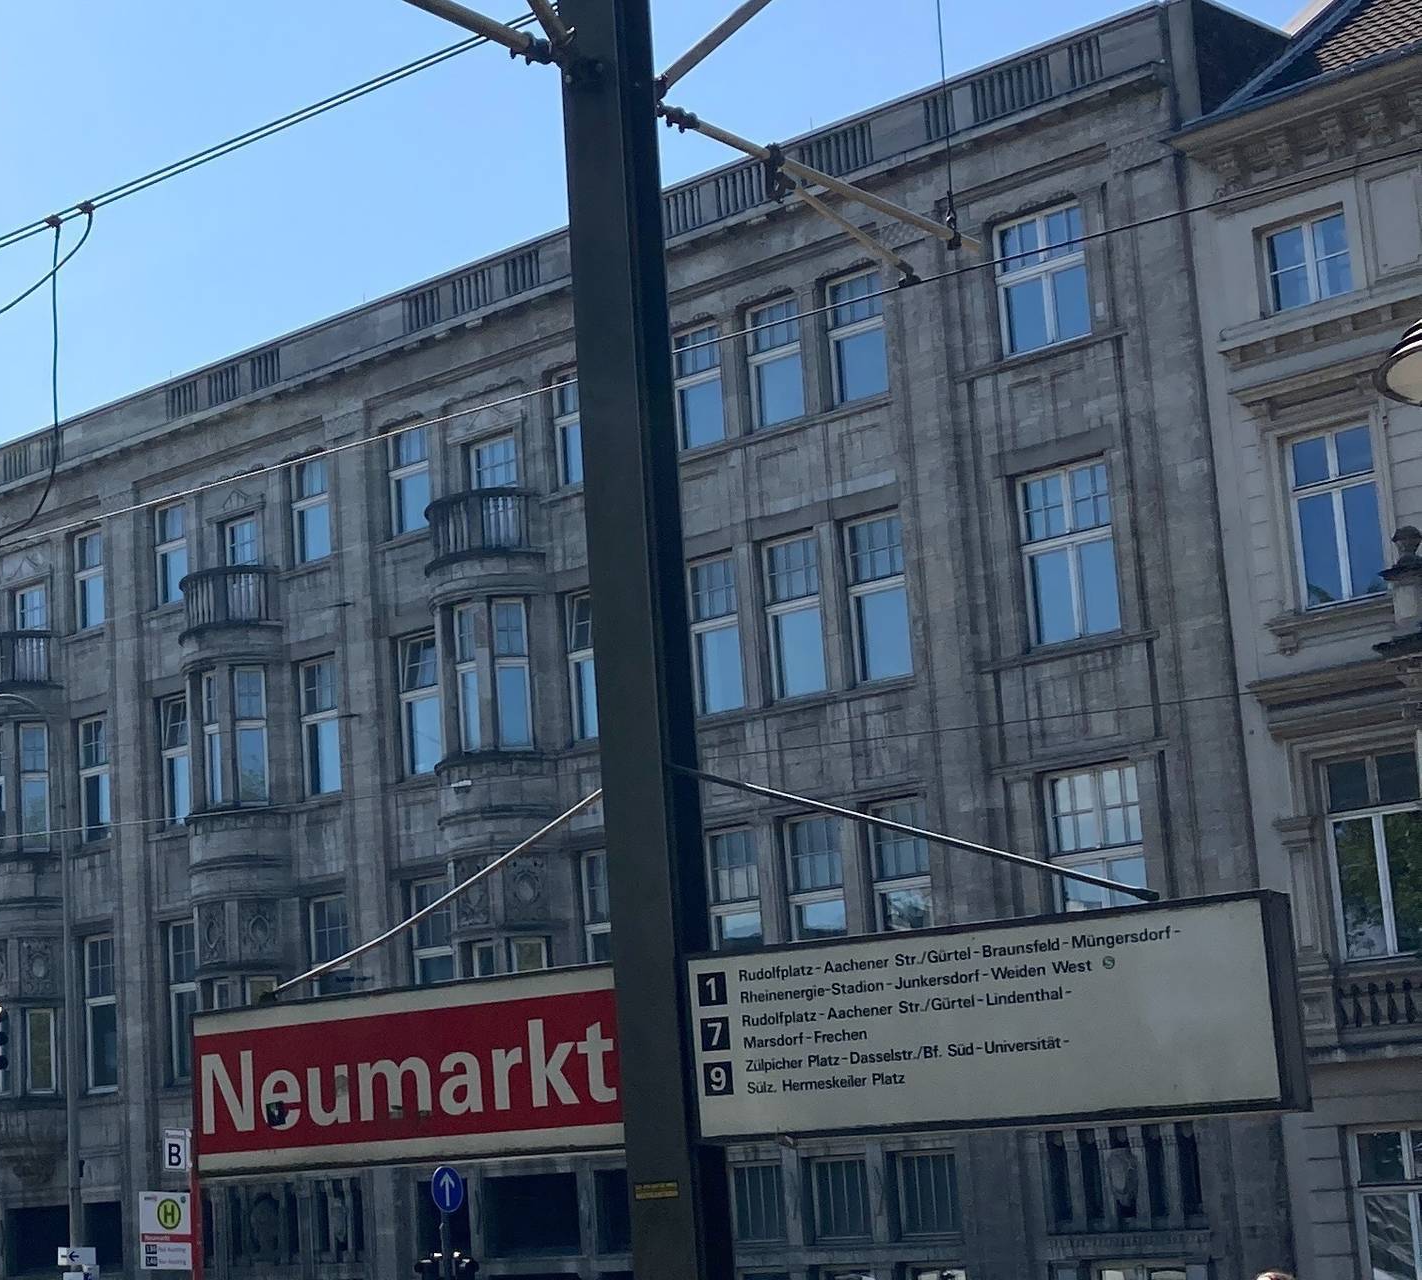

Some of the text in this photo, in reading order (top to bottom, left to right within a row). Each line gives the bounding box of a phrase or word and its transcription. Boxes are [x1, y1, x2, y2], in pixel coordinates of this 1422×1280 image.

[1052, 960, 1092, 974] West
[705, 977, 716, 1001] 1
[707, 1023, 722, 1046] 7
[198, 1018, 618, 1135] Neumarkt
[710, 1067, 726, 1091] 9
[745, 1056, 803, 1073] Zülpicher
[782, 1074, 867, 1092] Hermeskeiler
[872, 1072, 906, 1086] Platz
[168, 1143, 182, 1166] B
[163, 1204, 175, 1224] H
